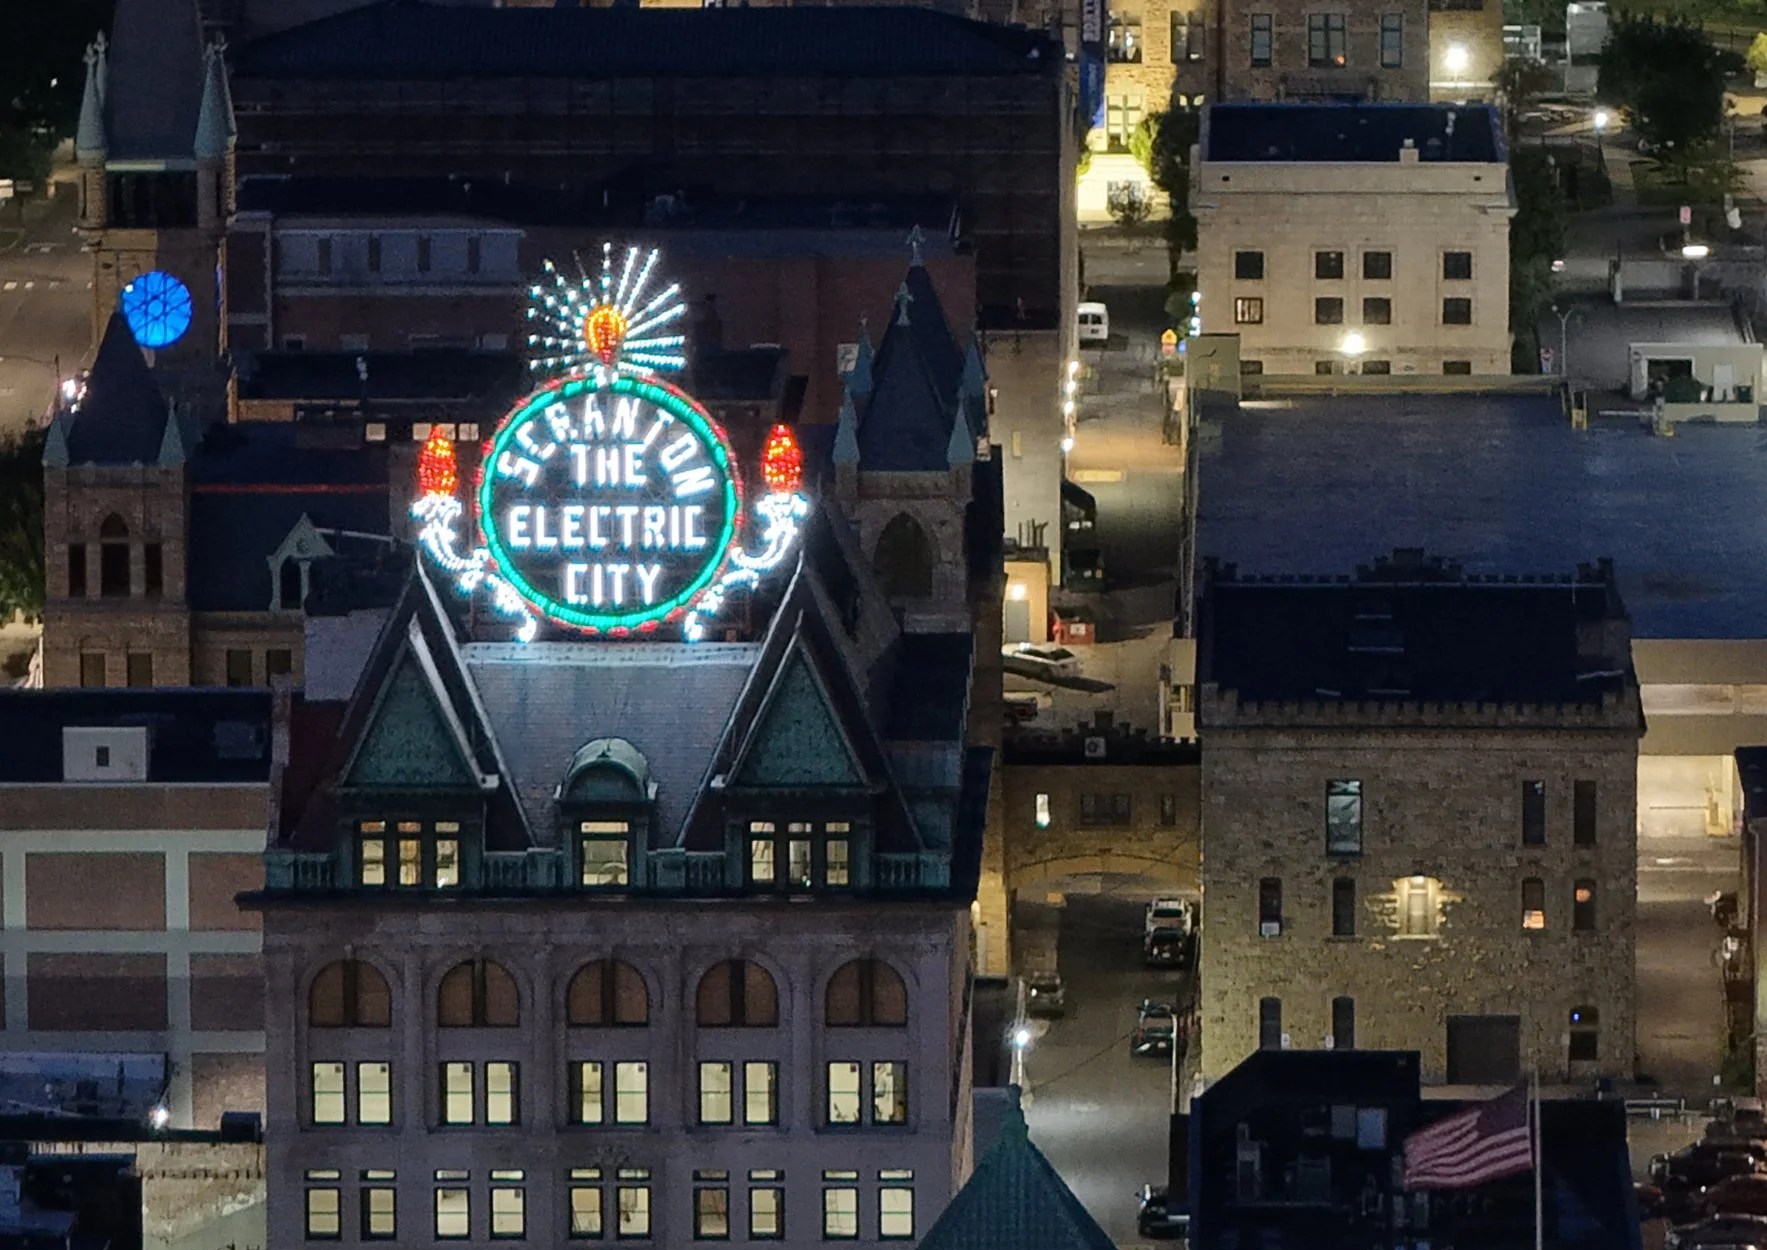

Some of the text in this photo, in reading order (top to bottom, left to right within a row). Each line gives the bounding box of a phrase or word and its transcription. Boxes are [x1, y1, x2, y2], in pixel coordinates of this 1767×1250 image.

[498, 394, 714, 497] SCRANTON
[570, 443, 648, 488] THE
[509, 505, 706, 551] ELECTRIC
[565, 563, 661, 606] CITY
